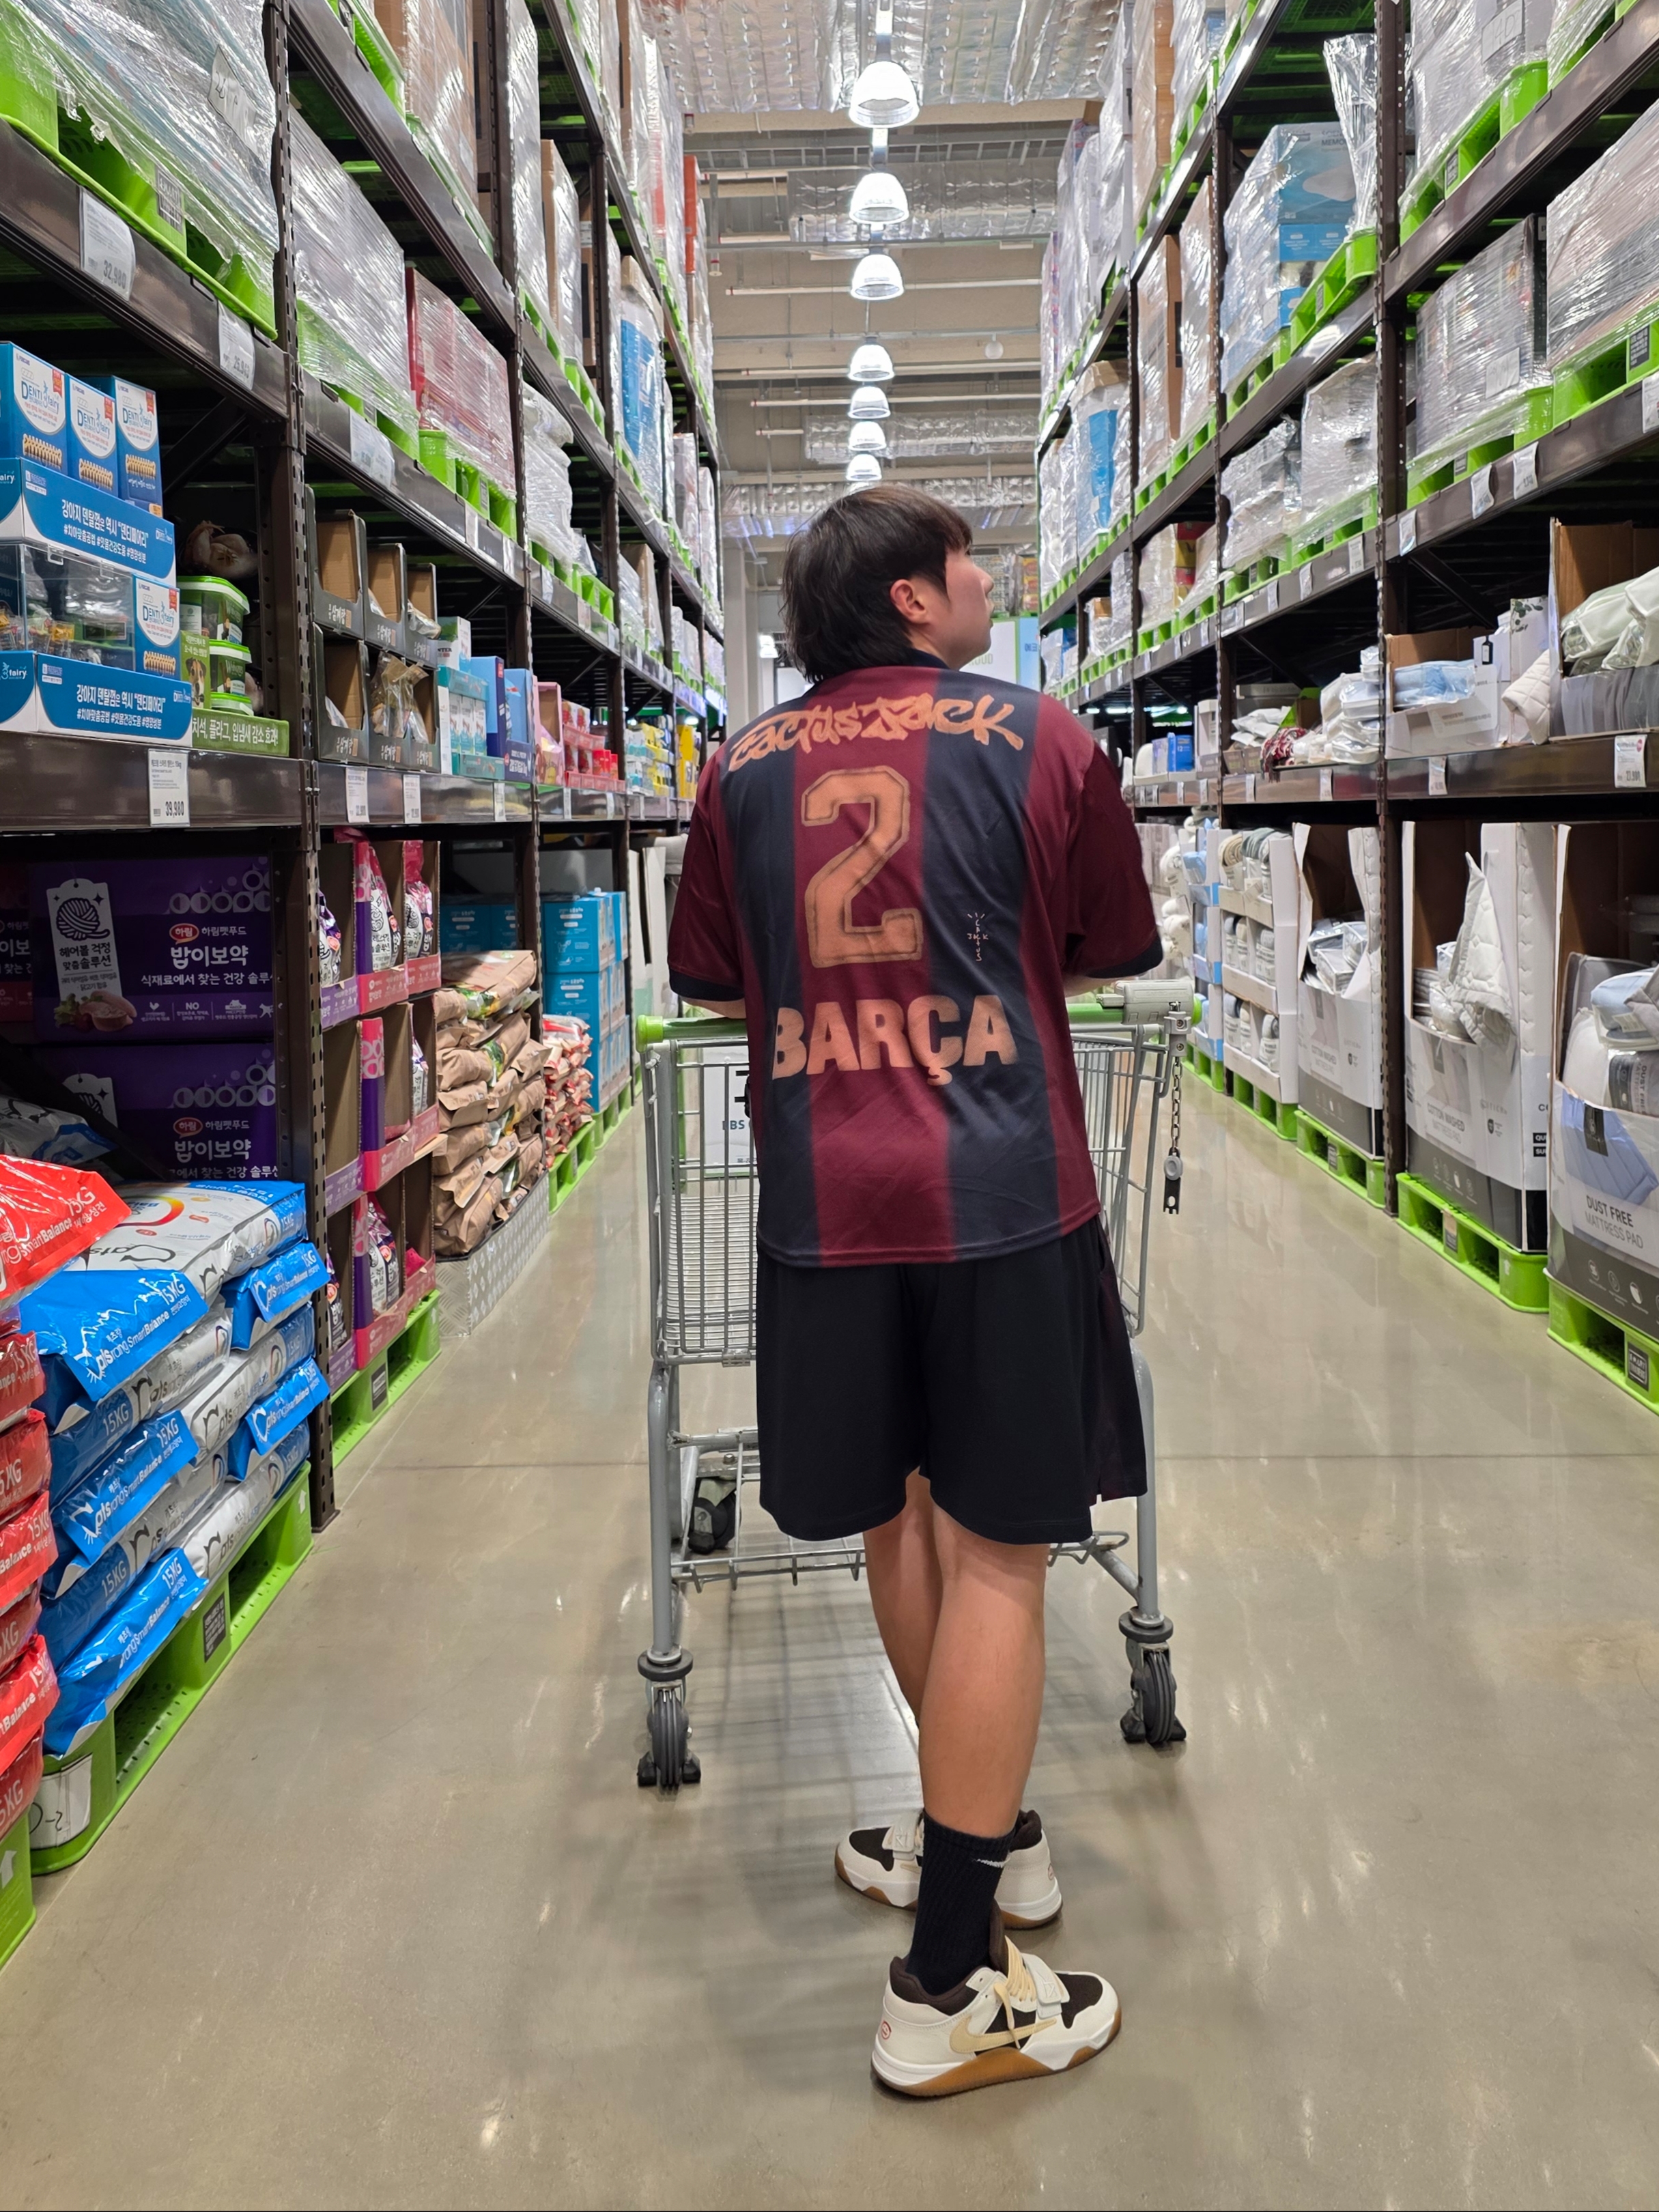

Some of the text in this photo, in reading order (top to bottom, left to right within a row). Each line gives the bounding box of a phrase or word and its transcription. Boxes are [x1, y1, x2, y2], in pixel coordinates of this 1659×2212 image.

[104, 259, 126, 289] 32,980
[61, 498, 82, 523] 강아지
[82, 507, 105, 533] 덴탈껌은
[106, 516, 117, 537] 역시
[76, 685, 96, 704] 강아지
[98, 687, 120, 708] 덴탈껌은
[122, 691, 133, 709] 역시
[232, 722, 251, 743] 입냄새
[252, 725, 264, 744] 감소
[165, 801, 184, 818] 39,980
[801, 765, 923, 969] 2
[175, 927, 193, 937] 하림
[201, 926, 247, 937] 하림펫푸드
[59, 942, 111, 958] 헤어볼 걱정
[171, 945, 249, 969] 밥이보약
[141, 972, 273, 987] 식재료에서 찾는 건강 솔루
[185, 1002, 200, 1010] NO
[772, 995, 1018, 1086] BARÇA
[178, 1121, 197, 1131] 하림
[205, 1120, 250, 1131] 하림펫푸드
[174, 1139, 252, 1163] 밥이보약
[169, 1167, 199, 1180] 에서
[201, 1167, 223, 1179] 찾는
[226, 1166, 248, 1179] 건강
[1586, 1195, 1634, 1228] DUST FREE
[1585, 1210, 1644, 1249] MATTRESS PAD
[159, 1280, 186, 1305] 15KG
[103, 1402, 130, 1436] 15KG
[157, 1418, 180, 1448] 15KG
[101, 1559, 127, 1598] 15KG
[162, 1556, 183, 1589] 15KG
